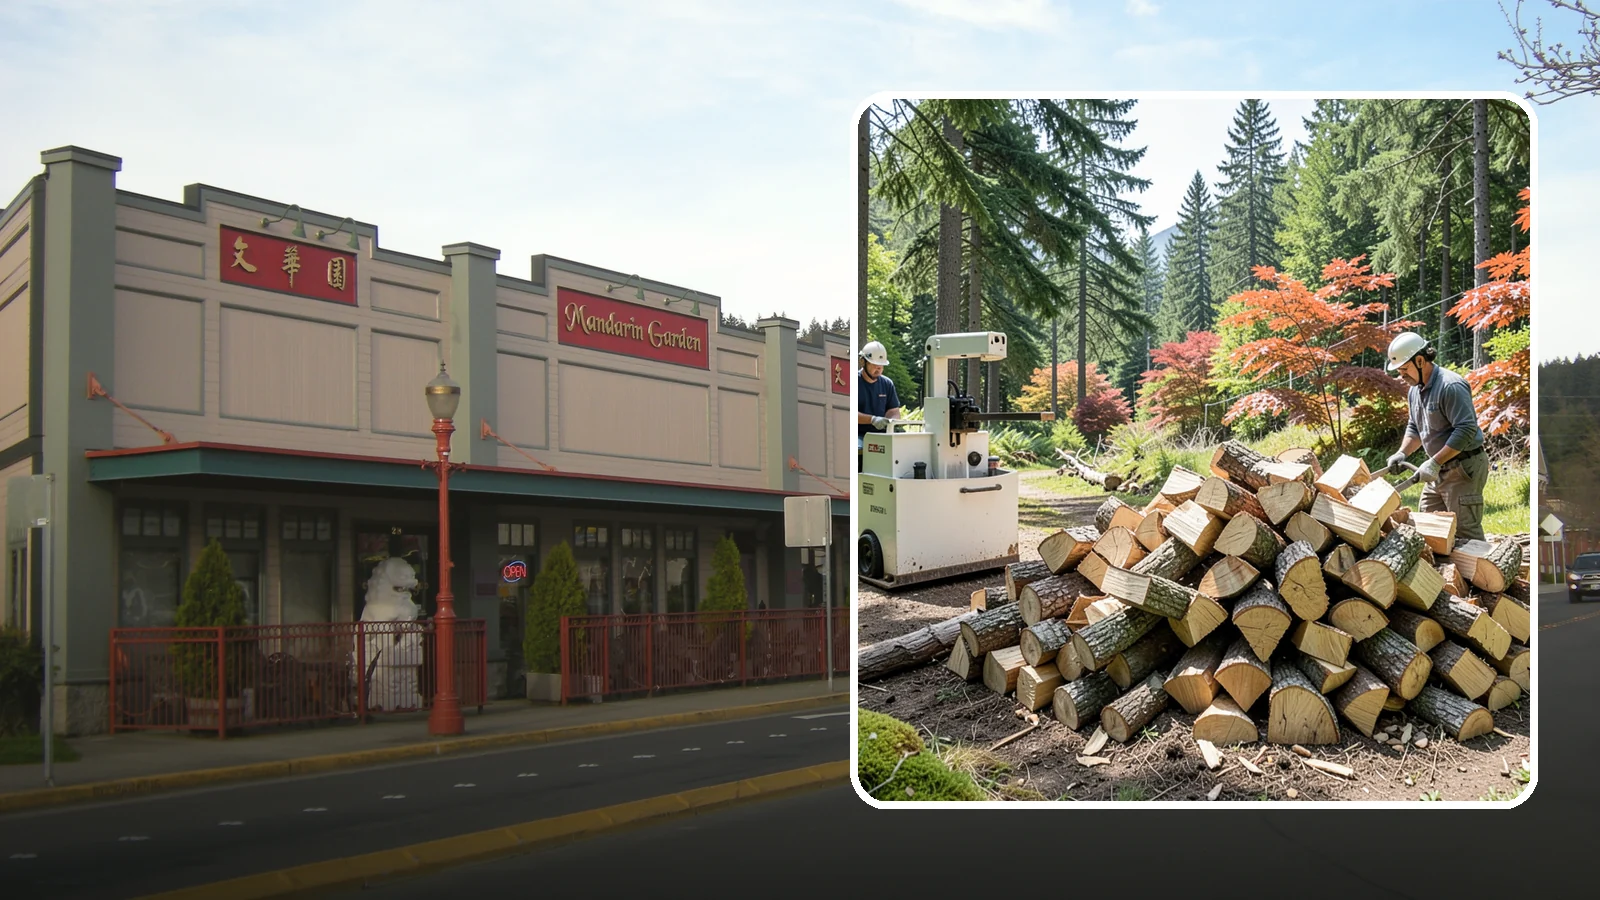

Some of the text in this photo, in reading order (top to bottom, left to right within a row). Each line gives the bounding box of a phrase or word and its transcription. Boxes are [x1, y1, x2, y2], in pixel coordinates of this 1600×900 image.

[230, 235, 346, 291] 文華園
[564, 302, 702, 352] Mandarin Garden
[503, 565, 527, 578] OPEN
